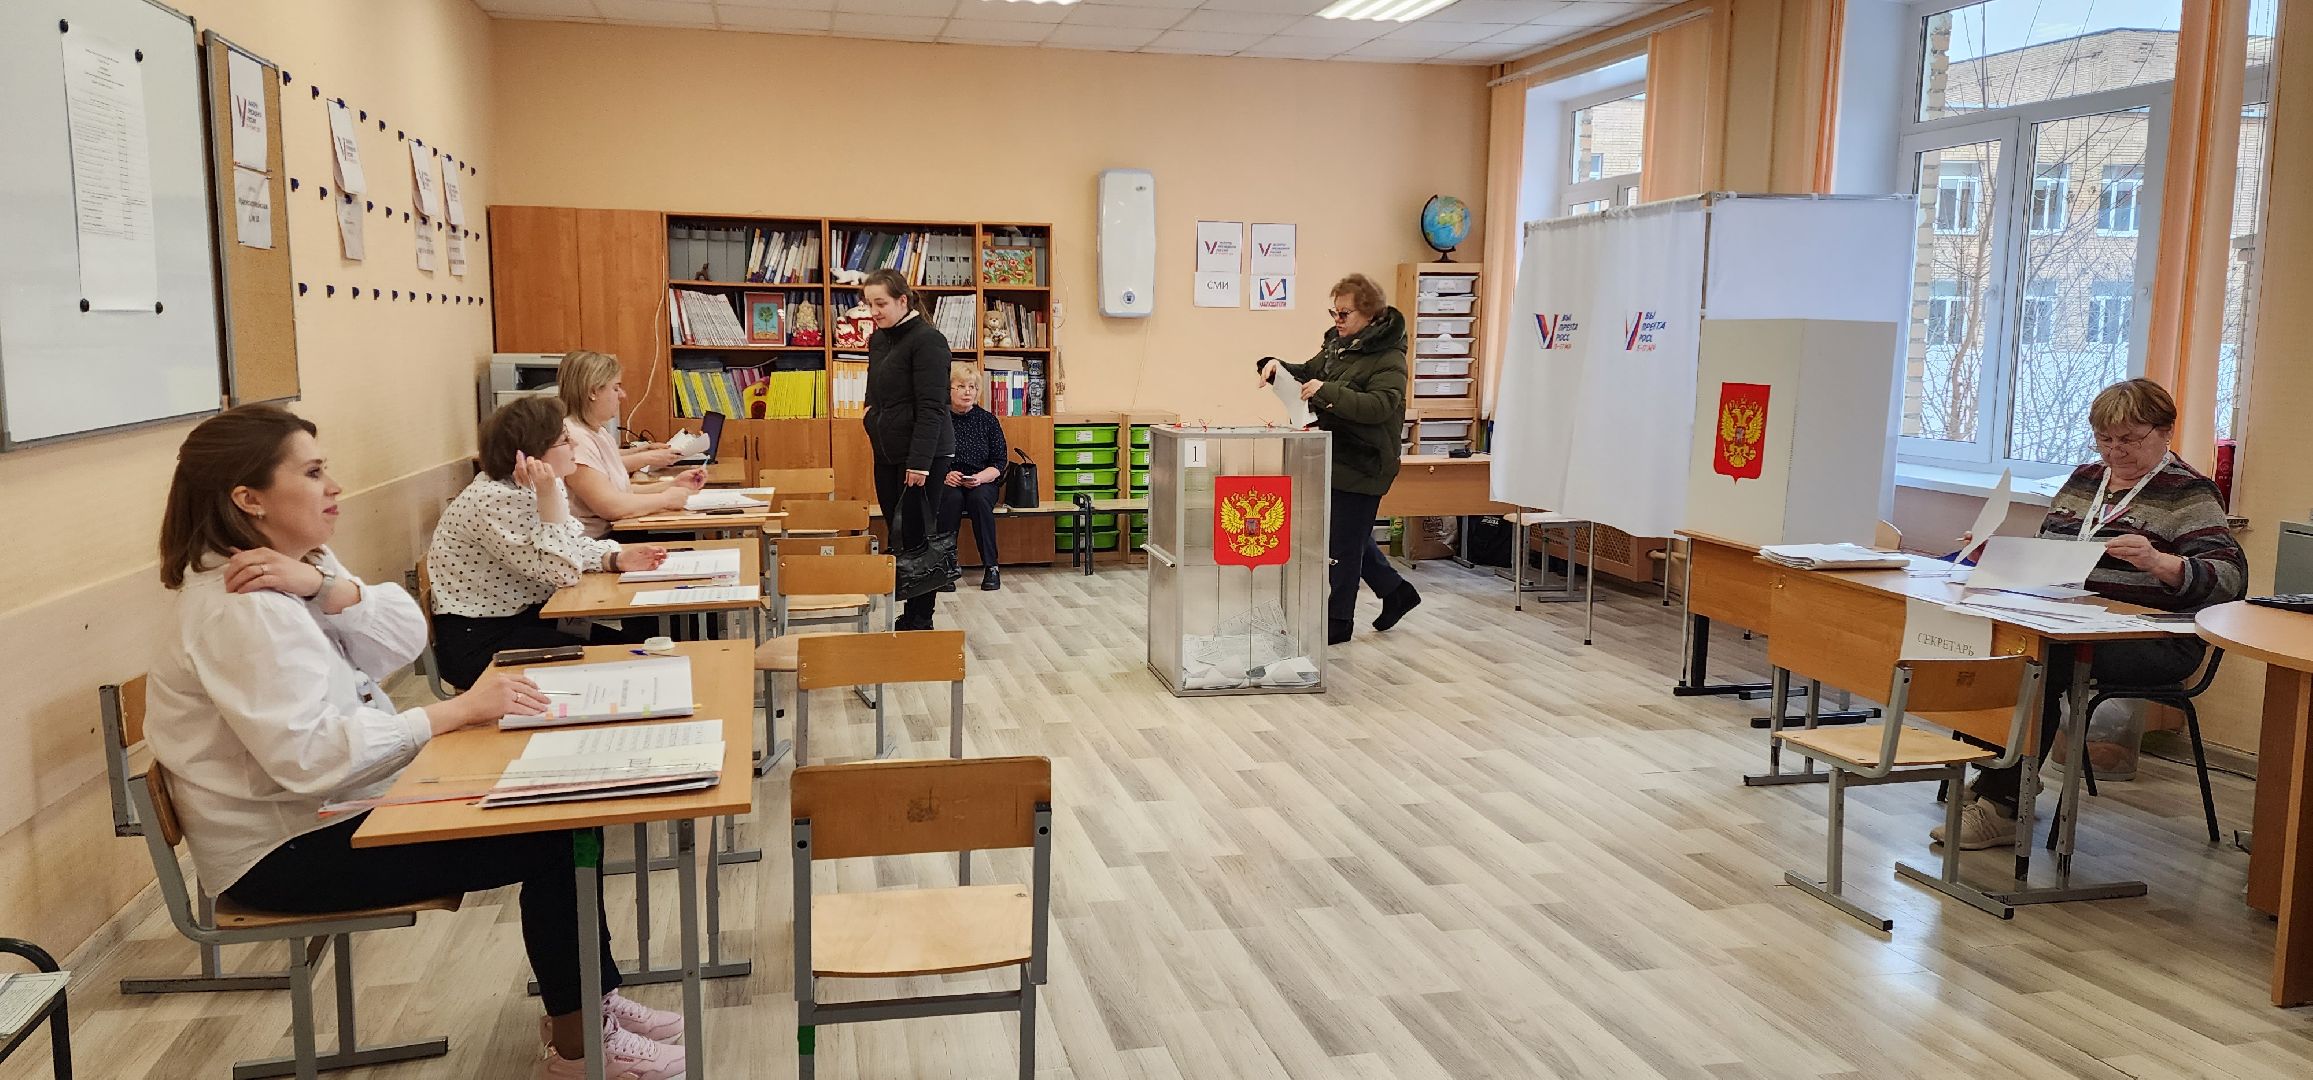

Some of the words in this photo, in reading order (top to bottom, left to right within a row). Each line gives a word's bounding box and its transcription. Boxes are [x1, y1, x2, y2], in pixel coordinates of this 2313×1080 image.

[1207, 281, 1229, 290] СМИ
[1193, 445, 1199, 463] 1
[1917, 632, 1975, 657] СЕКРЕТАРЬ
